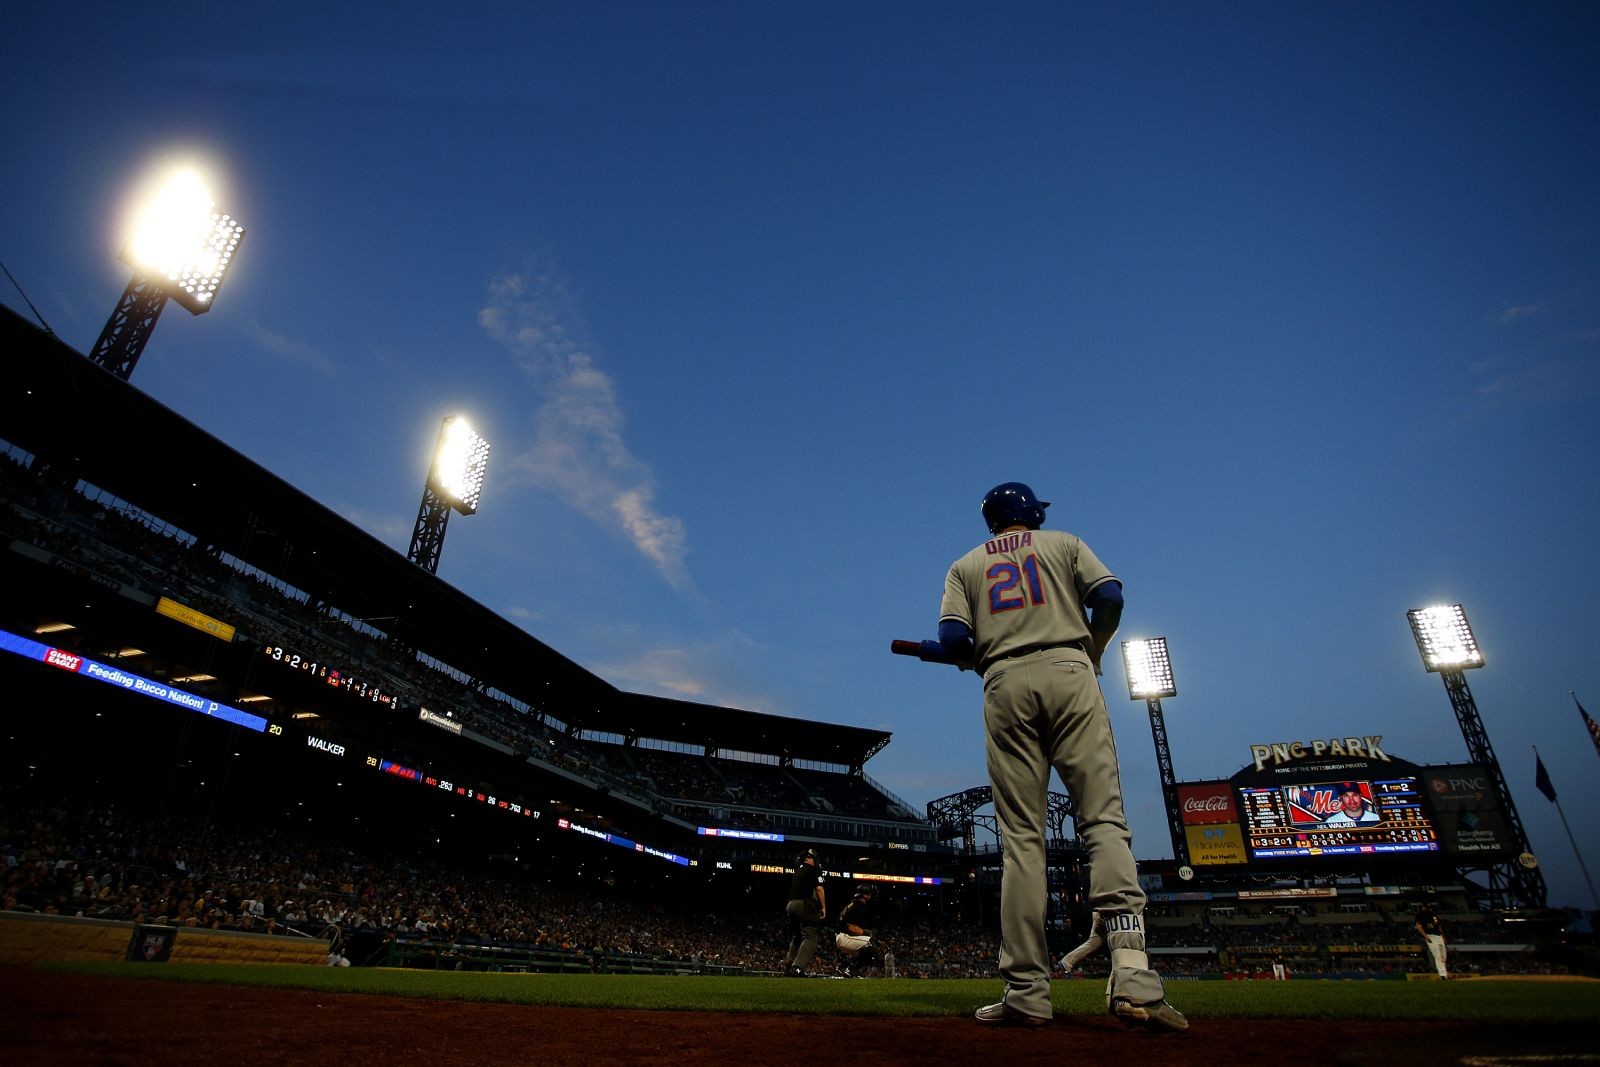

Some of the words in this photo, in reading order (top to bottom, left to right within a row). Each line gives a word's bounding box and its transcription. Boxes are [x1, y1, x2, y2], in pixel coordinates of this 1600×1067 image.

[985, 531, 1032, 555] DUDA
[986, 553, 1046, 615] 21
[48, 656, 77, 670] EAGLE
[50, 650, 80, 664] GIANT
[266, 646, 272, 654] B
[272, 647, 282, 660] 3
[284, 654, 290, 662] S
[290, 655, 300, 668] 2
[310, 663, 317, 674] 1
[88, 664, 134, 687] Feeding
[135, 679, 167, 697] Bucco
[168, 690, 204, 708] Nation!
[269, 724, 282, 735] 20
[307, 736, 346, 757] WALKER
[1250, 742, 1308, 772] PNC
[1311, 736, 1392, 763] PARK
[425, 777, 437, 786] AVG
[439, 780, 453, 791] .263
[1382, 784, 1388, 792] 1
[1401, 783, 1409, 791] 2
[1448, 778, 1487, 792] PNC
[468, 789, 473, 798] 5
[1184, 796, 1229, 812] Coca-Cola
[534, 811, 540, 819] 17
[716, 861, 732, 870] KUHL
